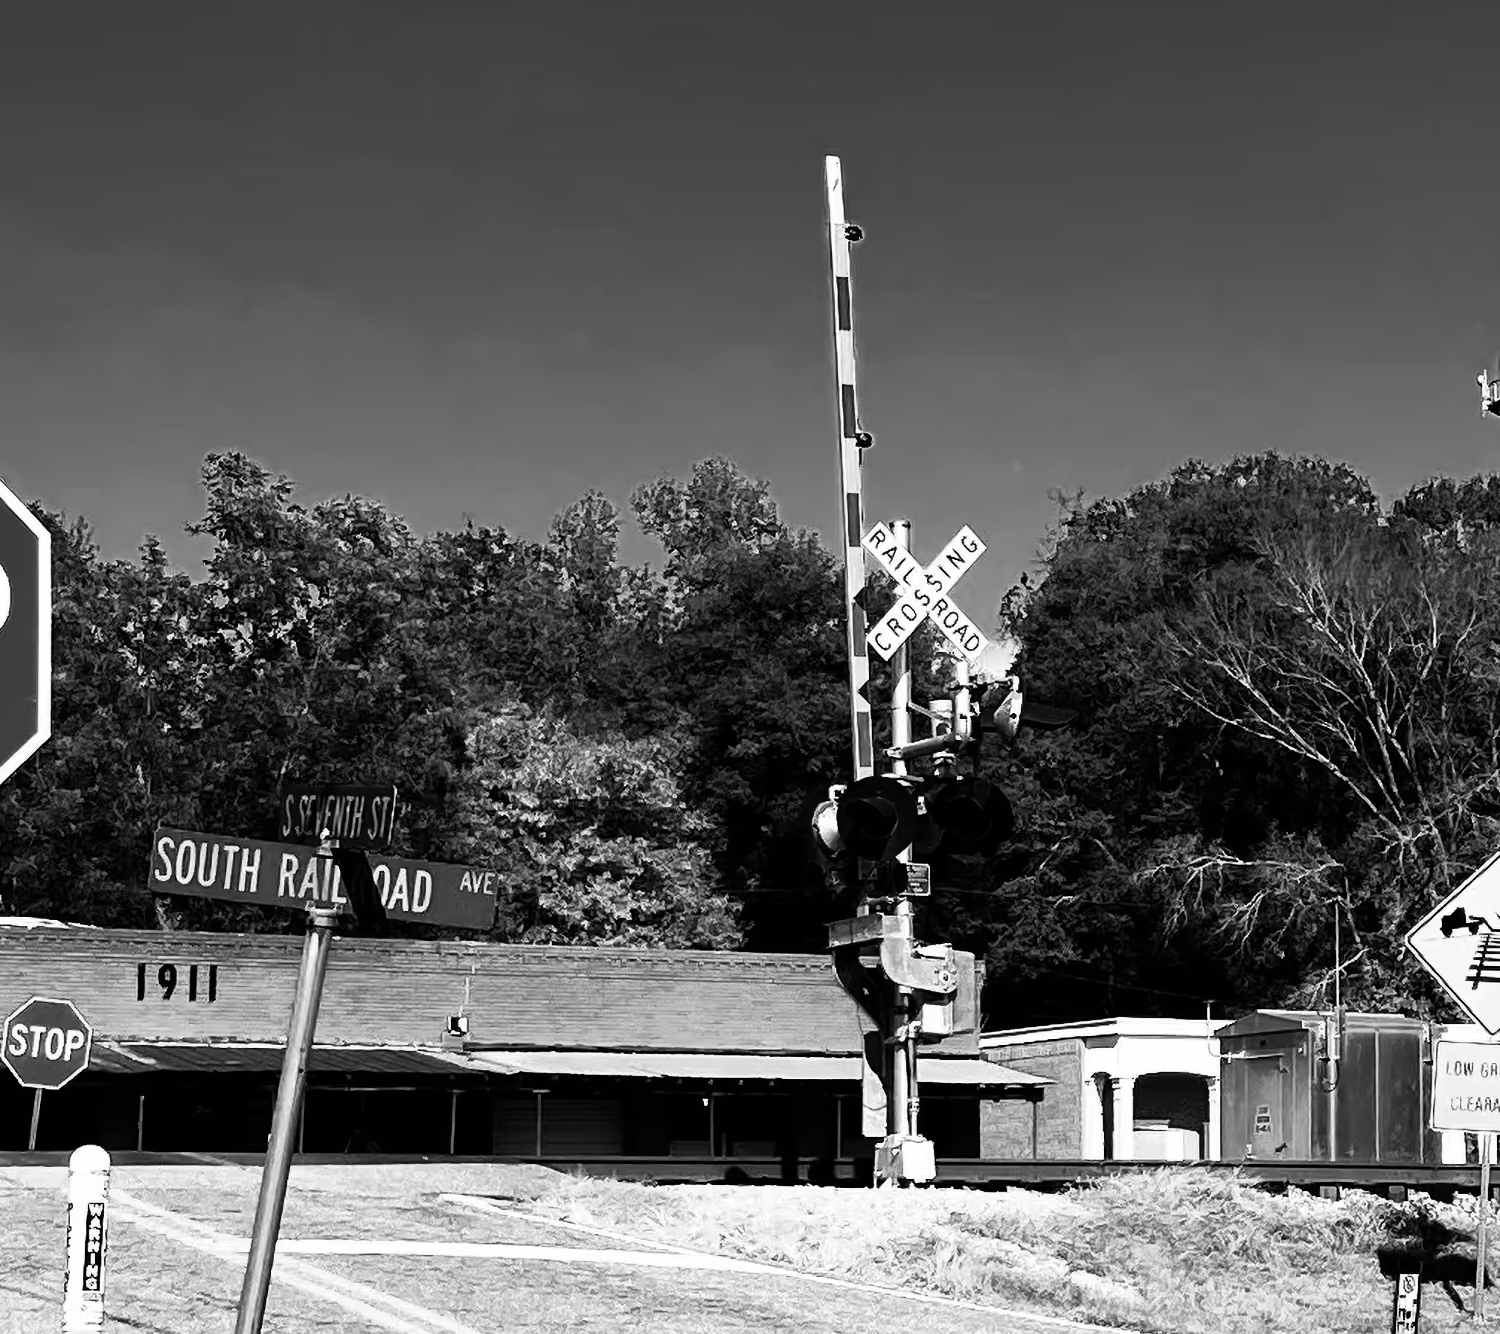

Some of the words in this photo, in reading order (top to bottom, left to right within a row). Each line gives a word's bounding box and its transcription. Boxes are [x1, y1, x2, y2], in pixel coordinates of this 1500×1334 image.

[875, 536, 978, 651] CROSSING
[282, 794, 295, 839] S
[367, 795, 391, 840] ST
[154, 837, 261, 893] SOUTH
[278, 852, 433, 913] RAILOAD
[460, 871, 496, 896] AVE
[137, 963, 218, 1003] 1911
[8, 1023, 85, 1061] STOP
[1446, 1061, 1474, 1077] LOW
[85, 1203, 104, 1290] WARNING
